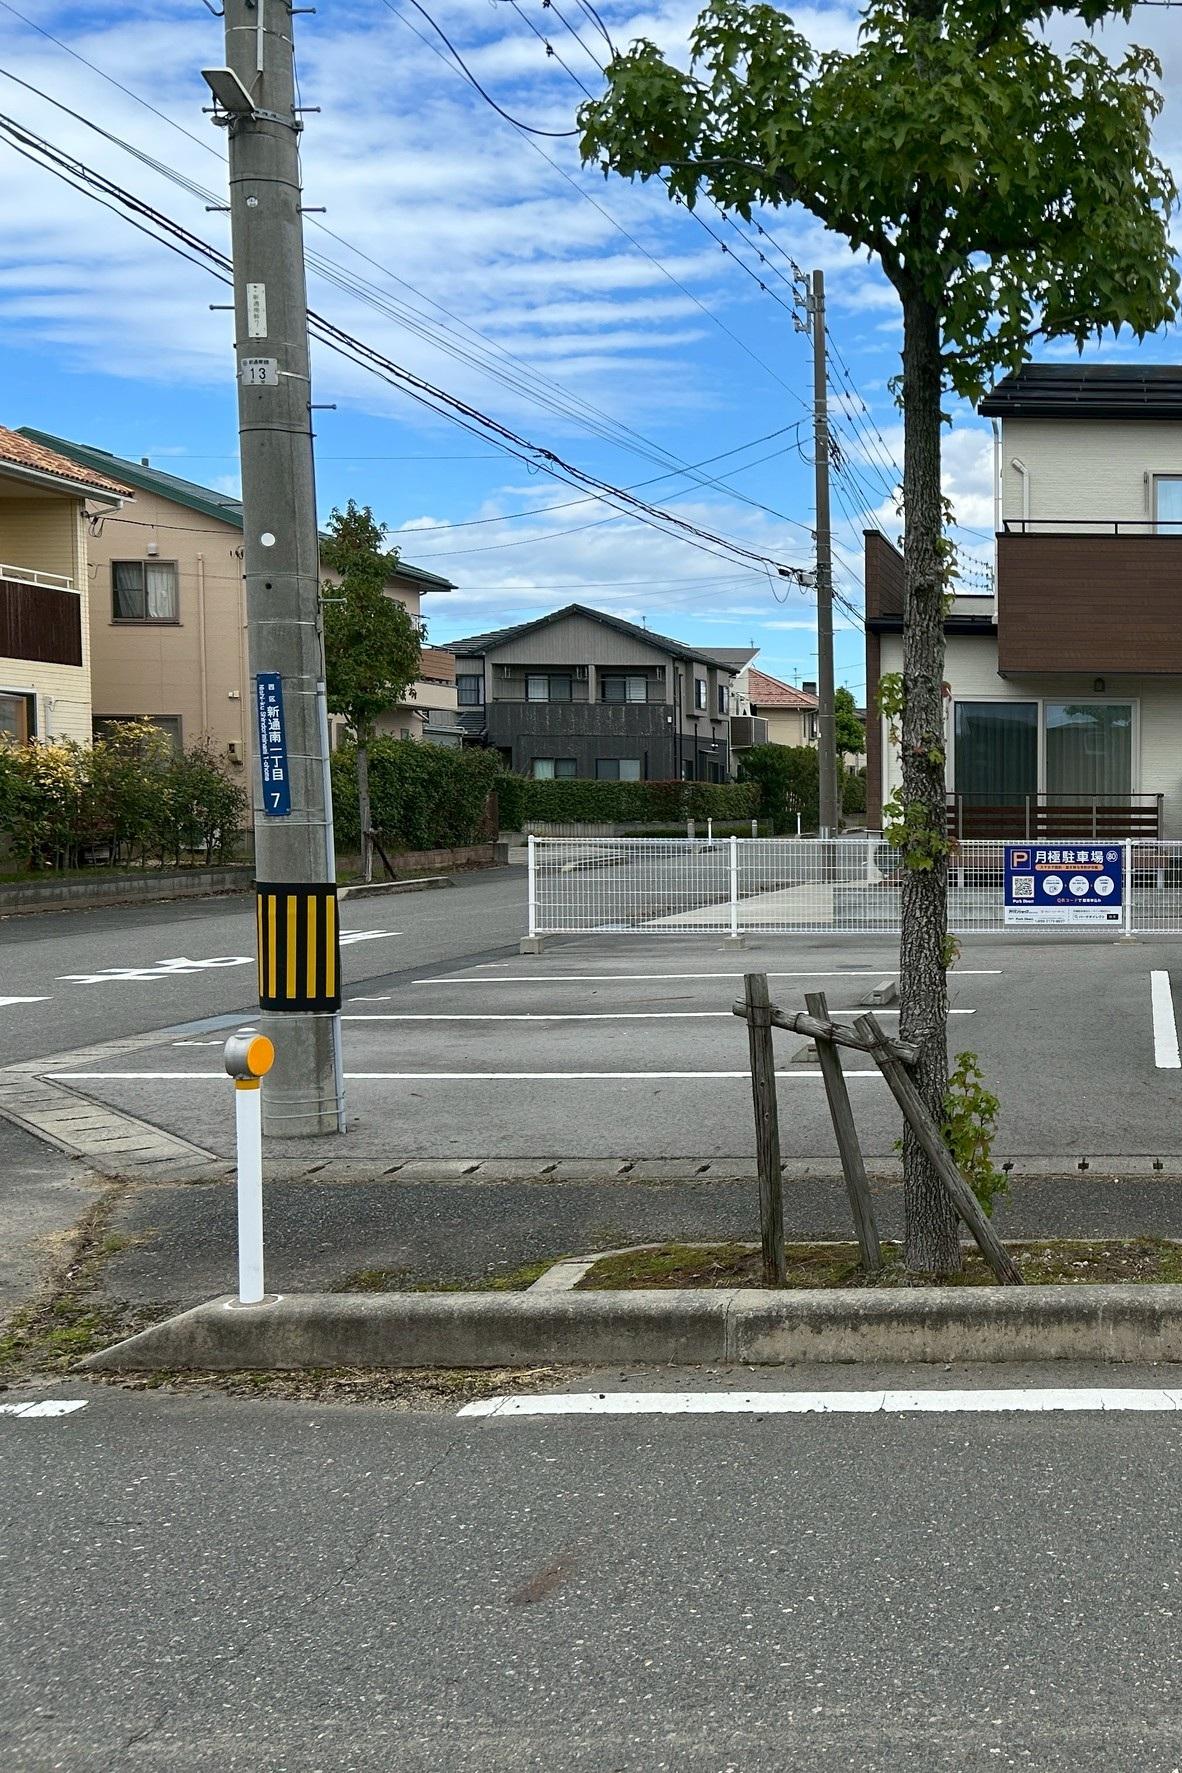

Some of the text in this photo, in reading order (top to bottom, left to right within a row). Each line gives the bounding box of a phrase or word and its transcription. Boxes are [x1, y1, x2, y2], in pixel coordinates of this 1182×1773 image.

[251, 367, 266, 379] 13
[266, 705, 284, 781] 新通南一丁目
[270, 792, 281, 808] 7
[1013, 851, 1028, 867] P
[1035, 850, 1104, 864] 月極駐車場
